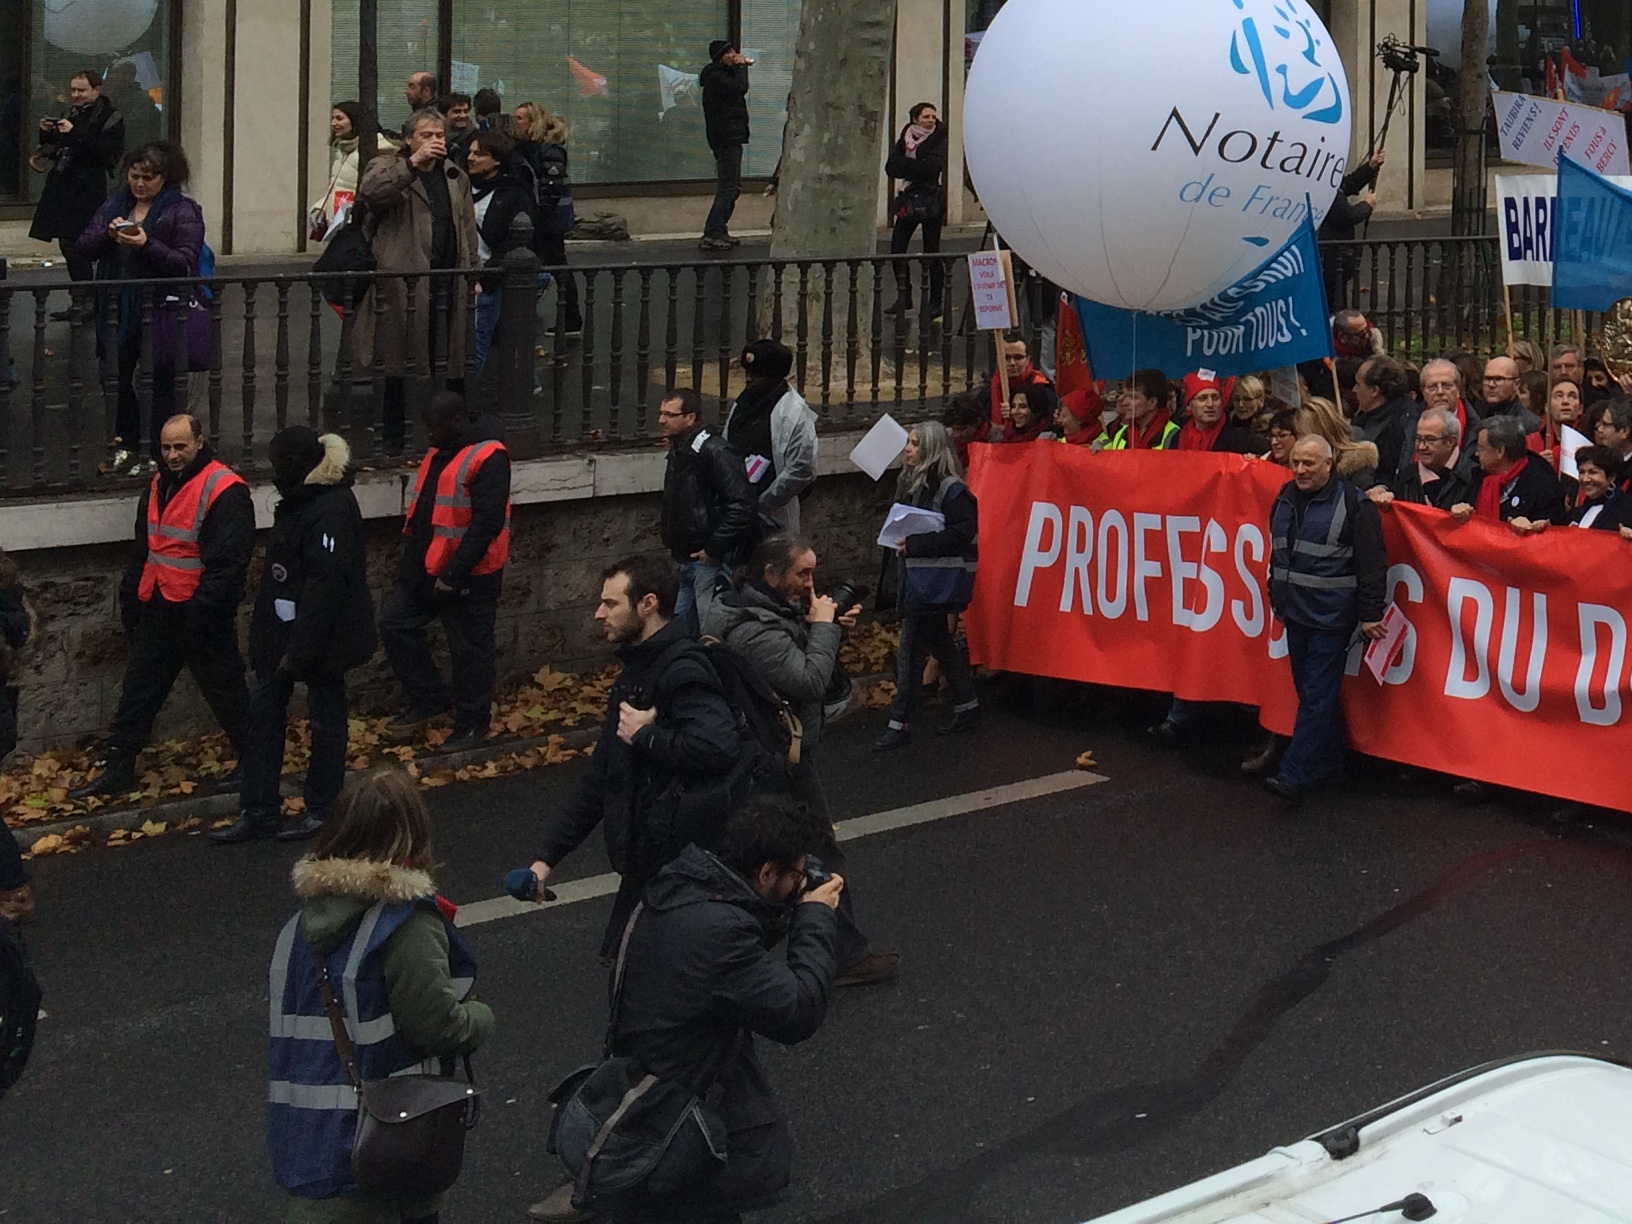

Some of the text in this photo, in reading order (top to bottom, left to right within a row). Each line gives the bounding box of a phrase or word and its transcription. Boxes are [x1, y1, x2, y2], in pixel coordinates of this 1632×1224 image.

[1500, 94, 1527, 137] TAUBIRA
[1178, 173, 1231, 208] de
[1186, 324, 1246, 357] POUR
[1013, 500, 1425, 686] PROFESSS
[1443, 576, 1548, 714] DU
